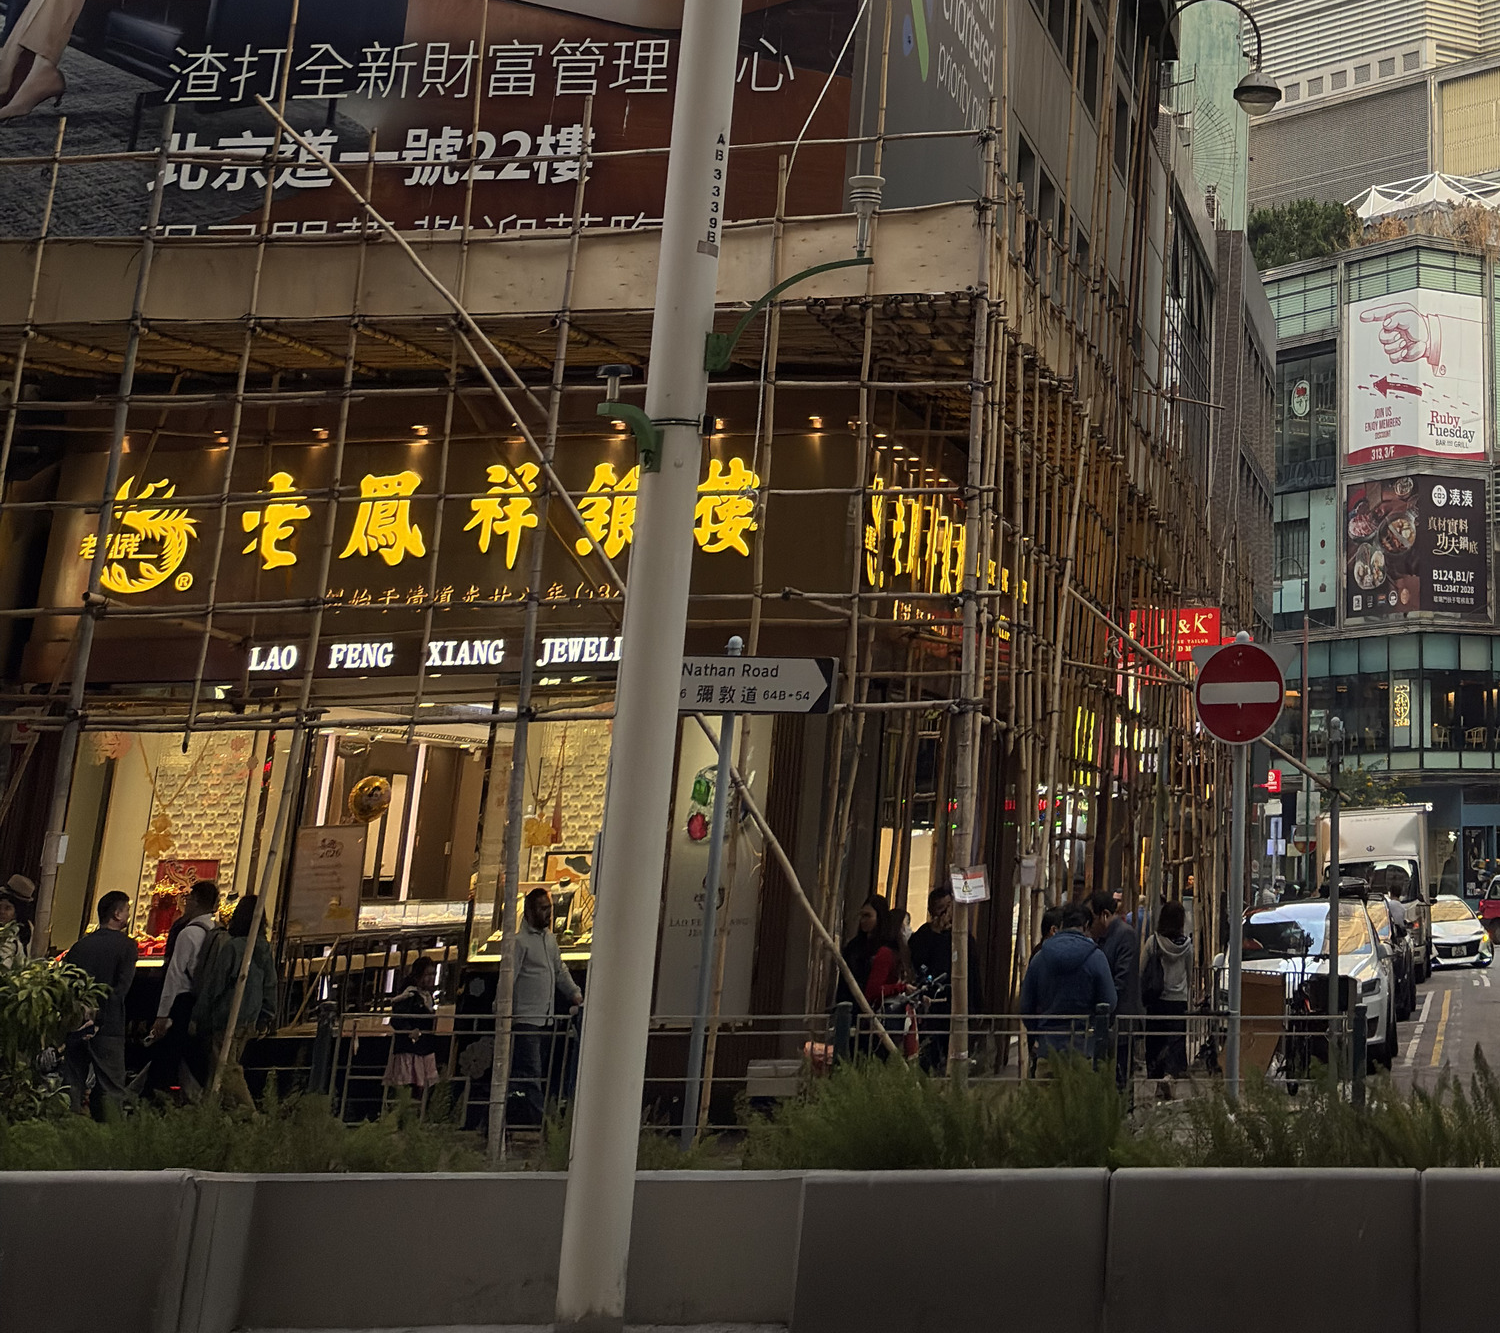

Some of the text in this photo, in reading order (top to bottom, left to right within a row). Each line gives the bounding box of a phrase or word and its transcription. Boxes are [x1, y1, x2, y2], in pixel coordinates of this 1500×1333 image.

[164, 37, 795, 103] 渣打全新財富管理心
[936, 42, 972, 129] priority
[147, 124, 595, 192] 北京道一號22樓
[1430, 410, 1461, 429] Ruby
[1427, 422, 1475, 443] Tuesday
[1448, 488, 1473, 508] 湊湊
[1432, 569, 1475, 584] B124,B1/F
[248, 645, 298, 672] LAO
[328, 642, 394, 670] FENG
[425, 639, 504, 667] XIANG
[682, 663, 779, 678] Nathan Road
[696, 684, 757, 705] 彌敦道
